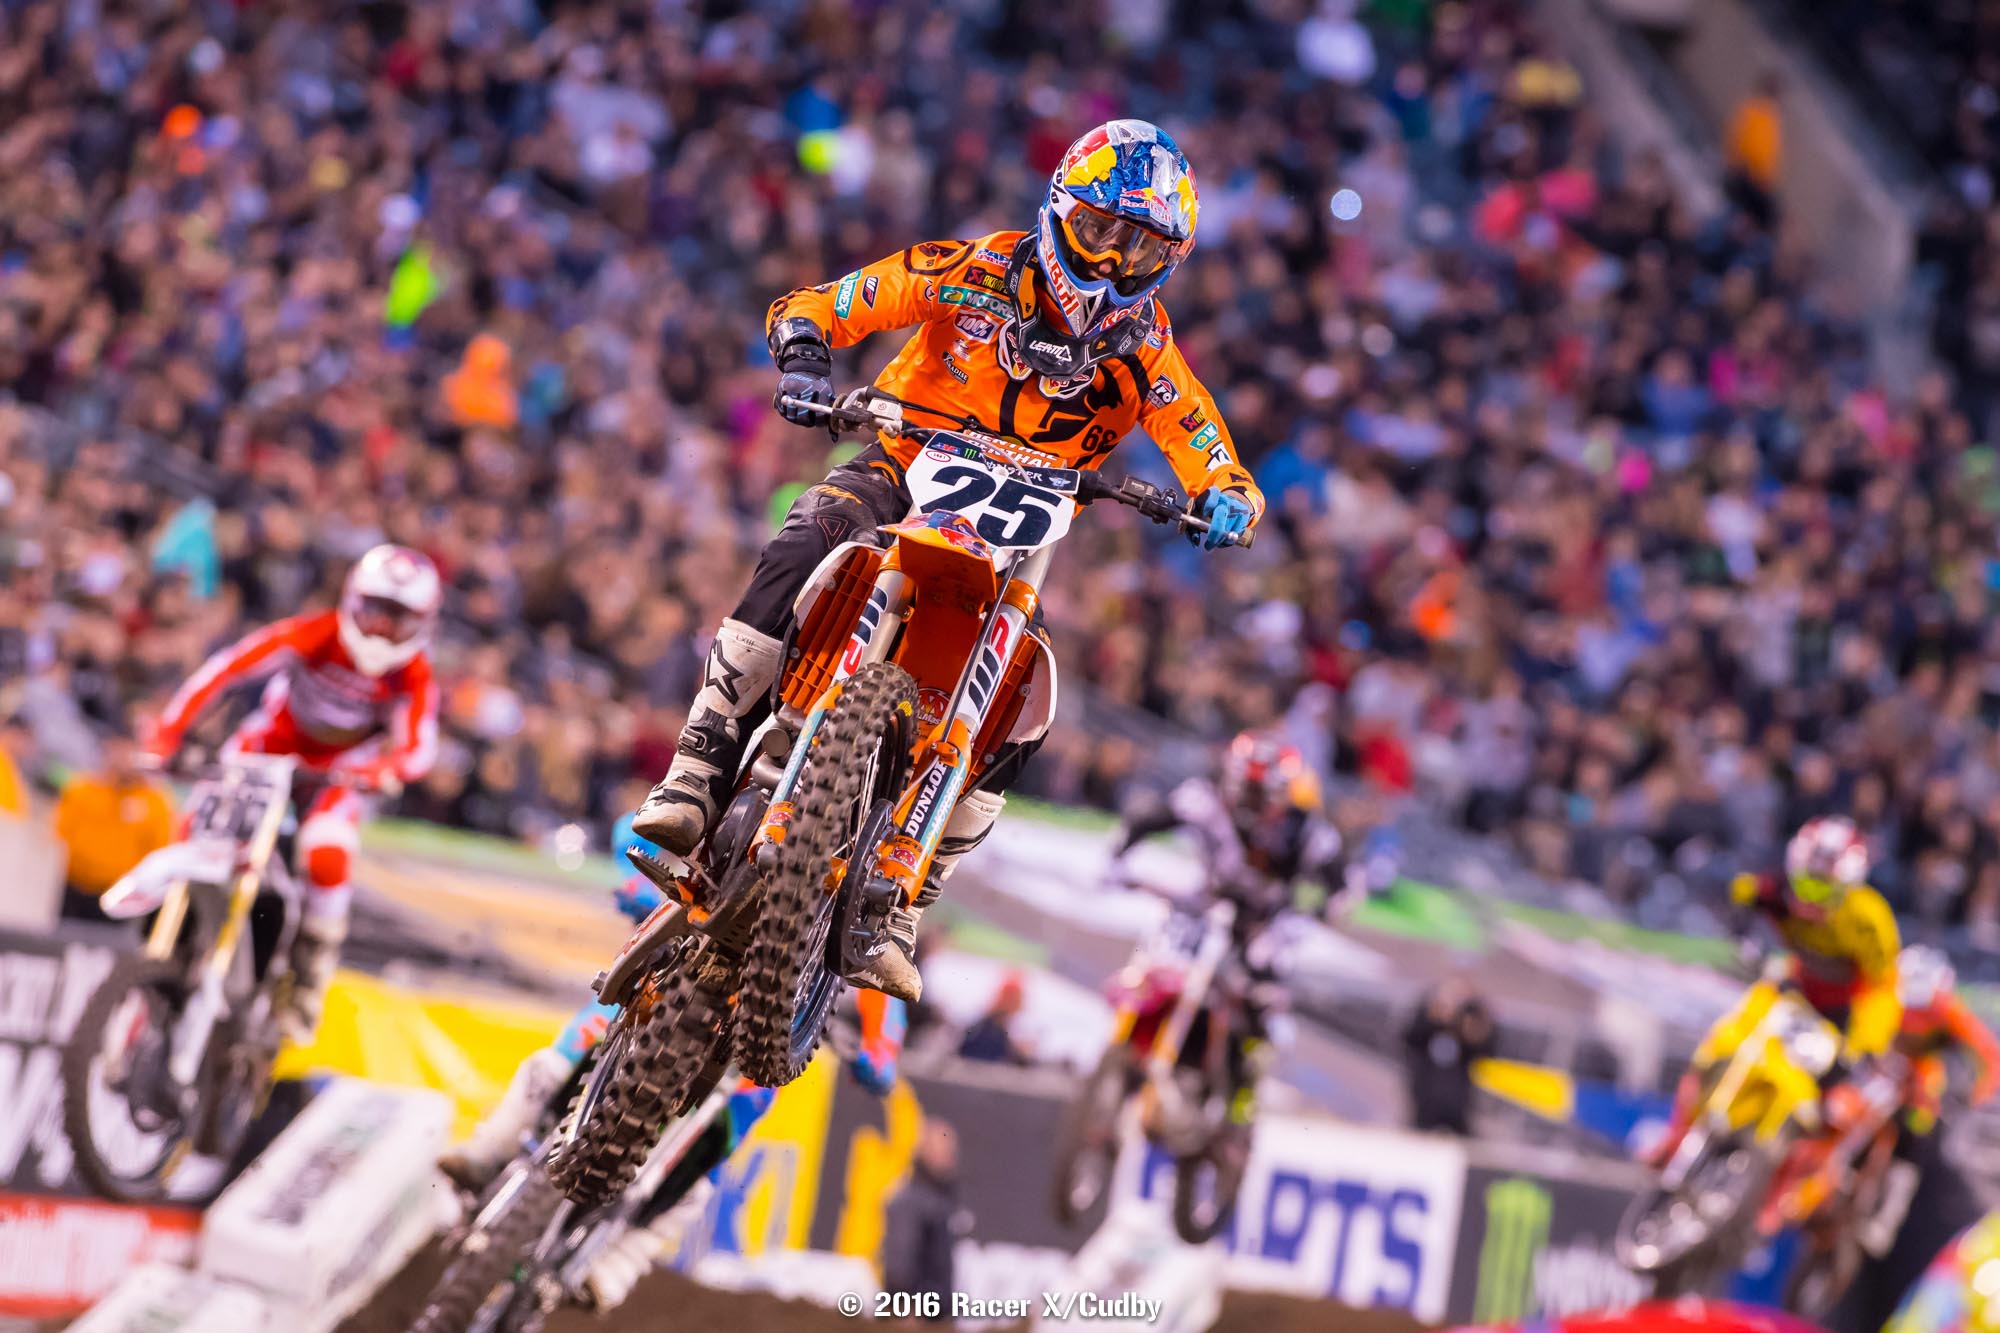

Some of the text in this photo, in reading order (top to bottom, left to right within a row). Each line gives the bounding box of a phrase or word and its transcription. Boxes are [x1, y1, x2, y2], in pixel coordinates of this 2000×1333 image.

[1119, 197, 1149, 209] Red
[1049, 260, 1081, 317] Bull
[965, 291, 1016, 320] MOTORE
[957, 315, 993, 337] 100%
[919, 465, 1063, 547] 25
